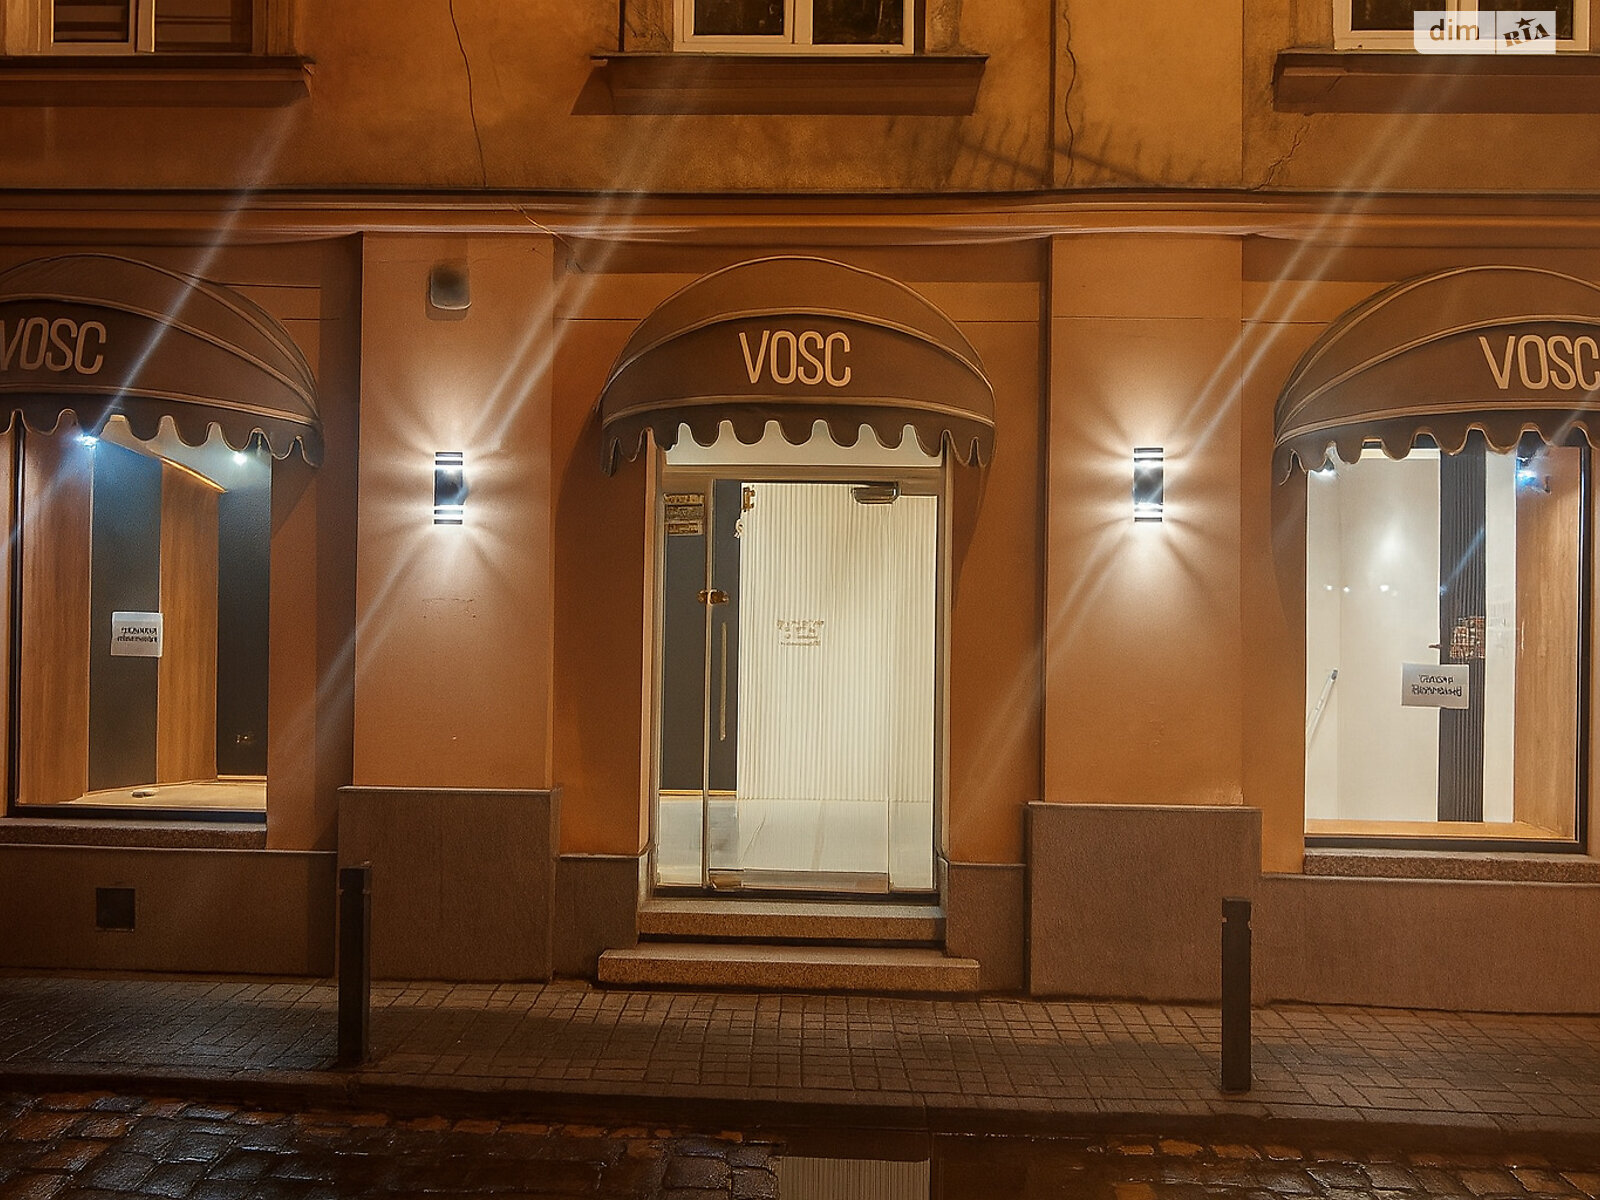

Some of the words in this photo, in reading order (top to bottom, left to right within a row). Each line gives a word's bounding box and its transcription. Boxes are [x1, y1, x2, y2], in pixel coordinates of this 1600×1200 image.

[0, 317, 106, 375] VOSC
[739, 330, 851, 387] VOSC
[1479, 335, 1600, 391] VOSC
